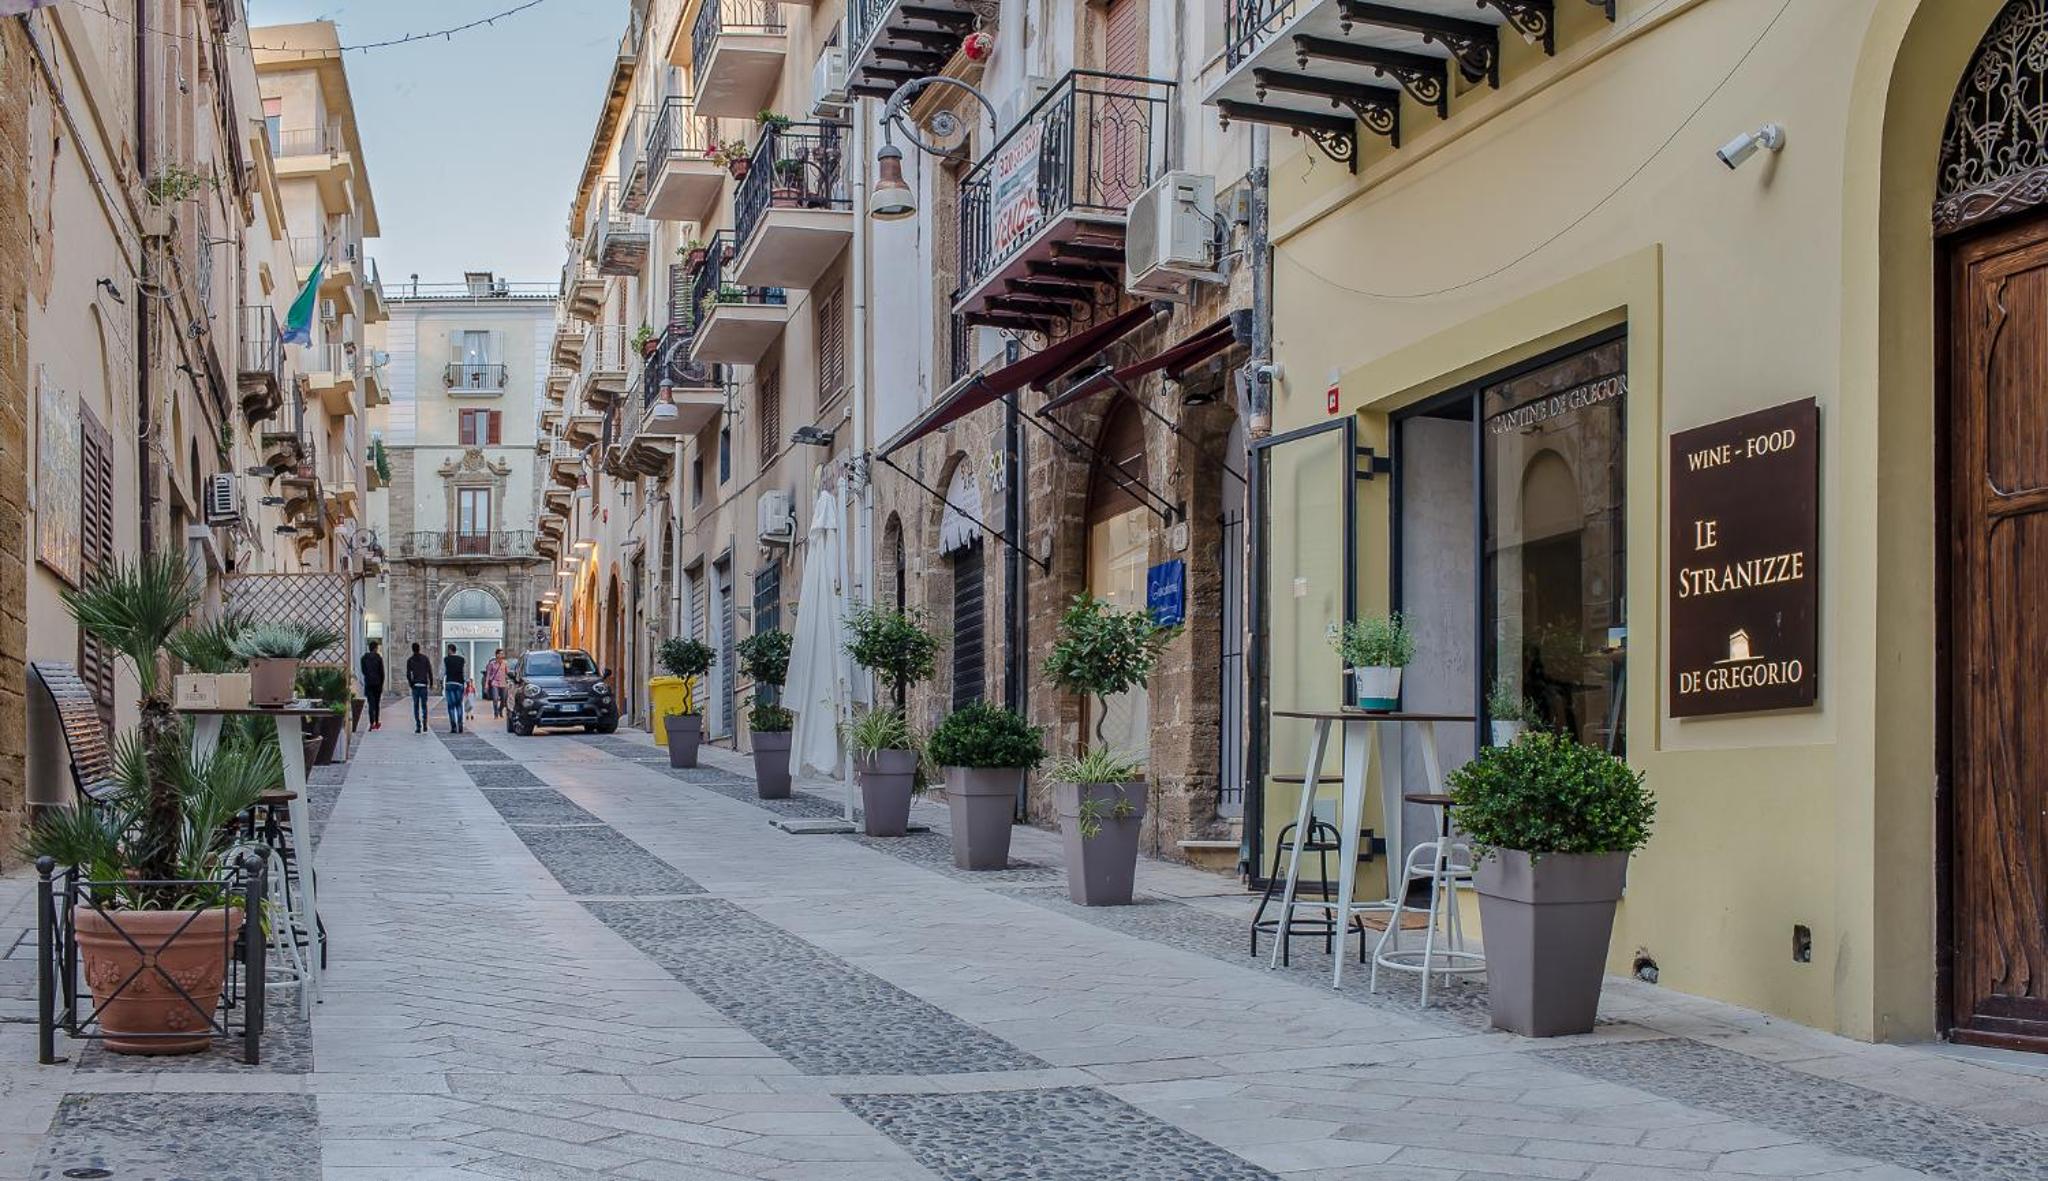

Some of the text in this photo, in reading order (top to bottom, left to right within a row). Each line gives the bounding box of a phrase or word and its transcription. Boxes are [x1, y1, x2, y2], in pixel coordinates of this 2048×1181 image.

[1491, 400, 1547, 434] CANTINE
[1550, 393, 1567, 417] DE
[1688, 445, 1731, 472] WINE
[1746, 429, 1796, 459] FOOD
[1694, 520, 1717, 550] LE
[1678, 551, 1803, 599] STRANIZZE
[1680, 660, 1803, 694] DE GREGORIO
